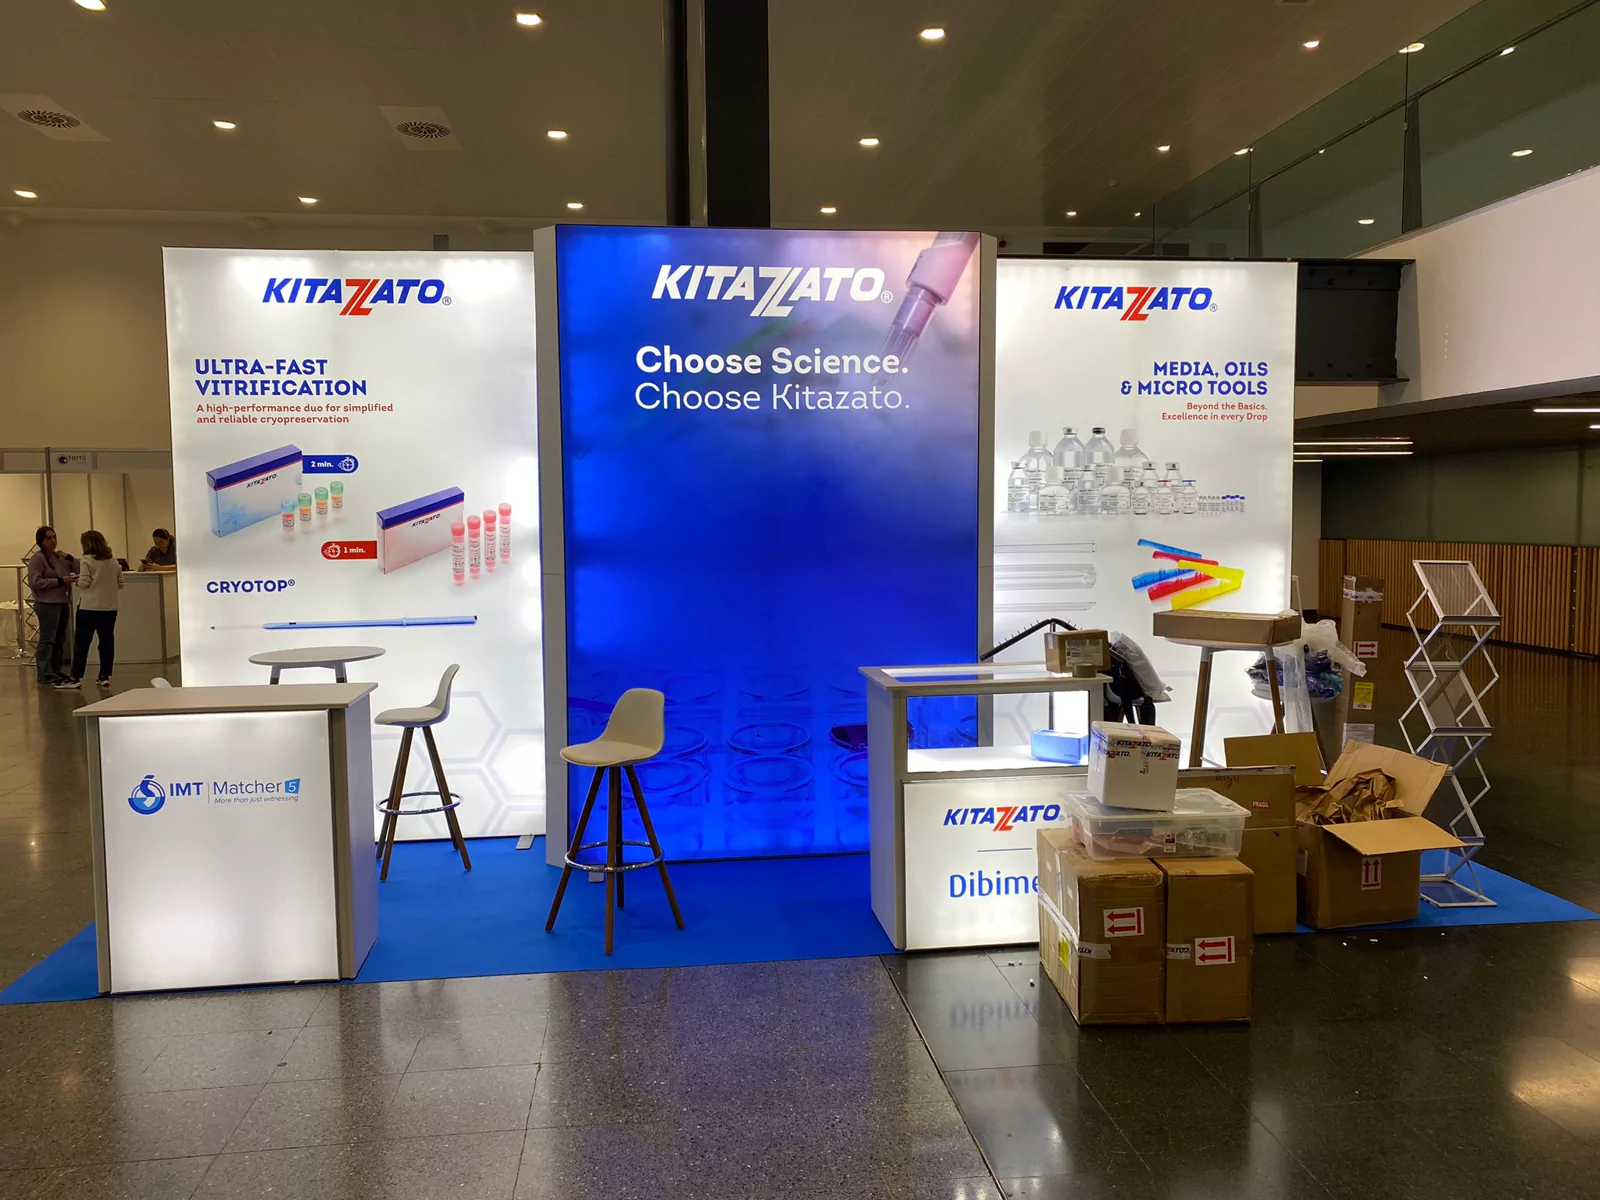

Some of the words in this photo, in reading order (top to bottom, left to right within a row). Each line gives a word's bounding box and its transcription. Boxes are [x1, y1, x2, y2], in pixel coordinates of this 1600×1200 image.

[195, 358, 328, 375] ULTRA-FAST
[636, 345, 762, 374] Choose
[771, 347, 909, 374] Science.
[1153, 361, 1219, 378] MEDIA,
[1224, 361, 1269, 377] OILS
[194, 379, 367, 396] VITRIFICATION
[1120, 380, 1133, 396] &
[1137, 380, 1203, 396] MICRO
[1207, 380, 1268, 396] TOOLS
[635, 382, 761, 410] Choose
[773, 383, 911, 410] Kitazato.
[196, 404, 205, 412] A
[206, 404, 302, 414] high-performance
[304, 403, 323, 412] duo
[325, 403, 342, 412] for
[343, 402, 394, 415] simplified
[1187, 402, 1219, 412] Beyond
[1220, 402, 1236, 411] the
[1237, 402, 1268, 411] Basics.
[196, 415, 216, 424] and
[218, 414, 258, 424] reliable
[260, 414, 350, 425] cryopreservation
[1161, 412, 1209, 421] Excellence
[1210, 412, 1219, 421] in
[1220, 414, 1245, 423] every
[1246, 412, 1268, 423] Drop
[310, 460, 316, 468] 2
[317, 460, 334, 468] min.
[349, 546, 366, 554] min.
[169, 781, 204, 797] IMT
[213, 779, 282, 796] Matcher
[233, 796, 249, 804] than
[250, 796, 263, 804] just
[264, 795, 299, 804] witnessing
